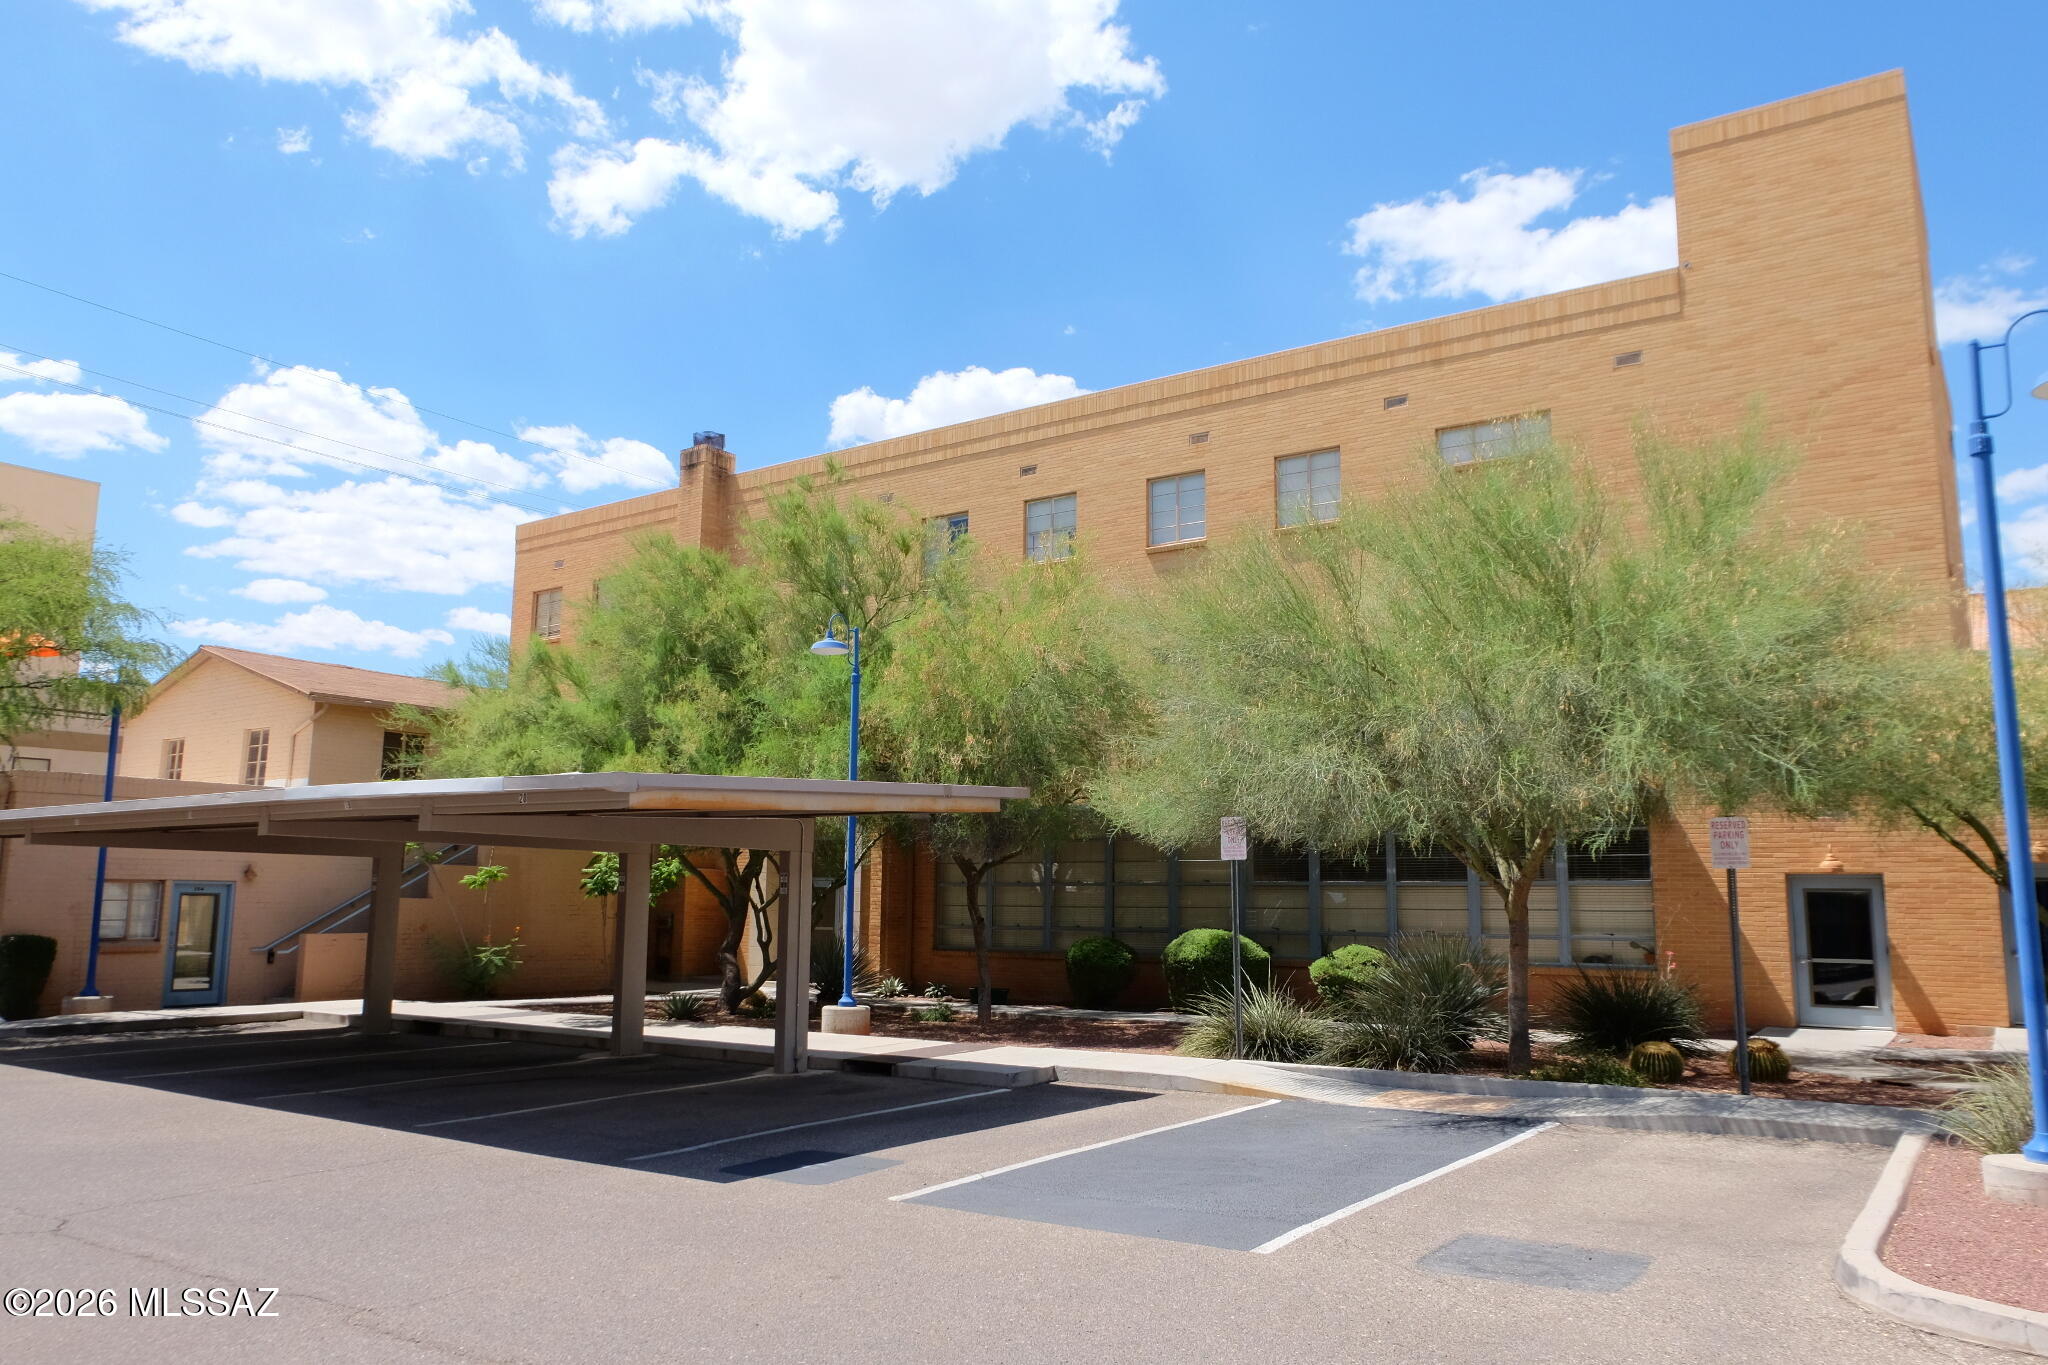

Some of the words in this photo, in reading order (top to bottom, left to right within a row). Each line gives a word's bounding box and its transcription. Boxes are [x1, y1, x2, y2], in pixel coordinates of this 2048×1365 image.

[1711, 821, 1746, 830] RESERVED
[1713, 831, 1745, 840] PARKING
[1720, 841, 1739, 850] ONLY
